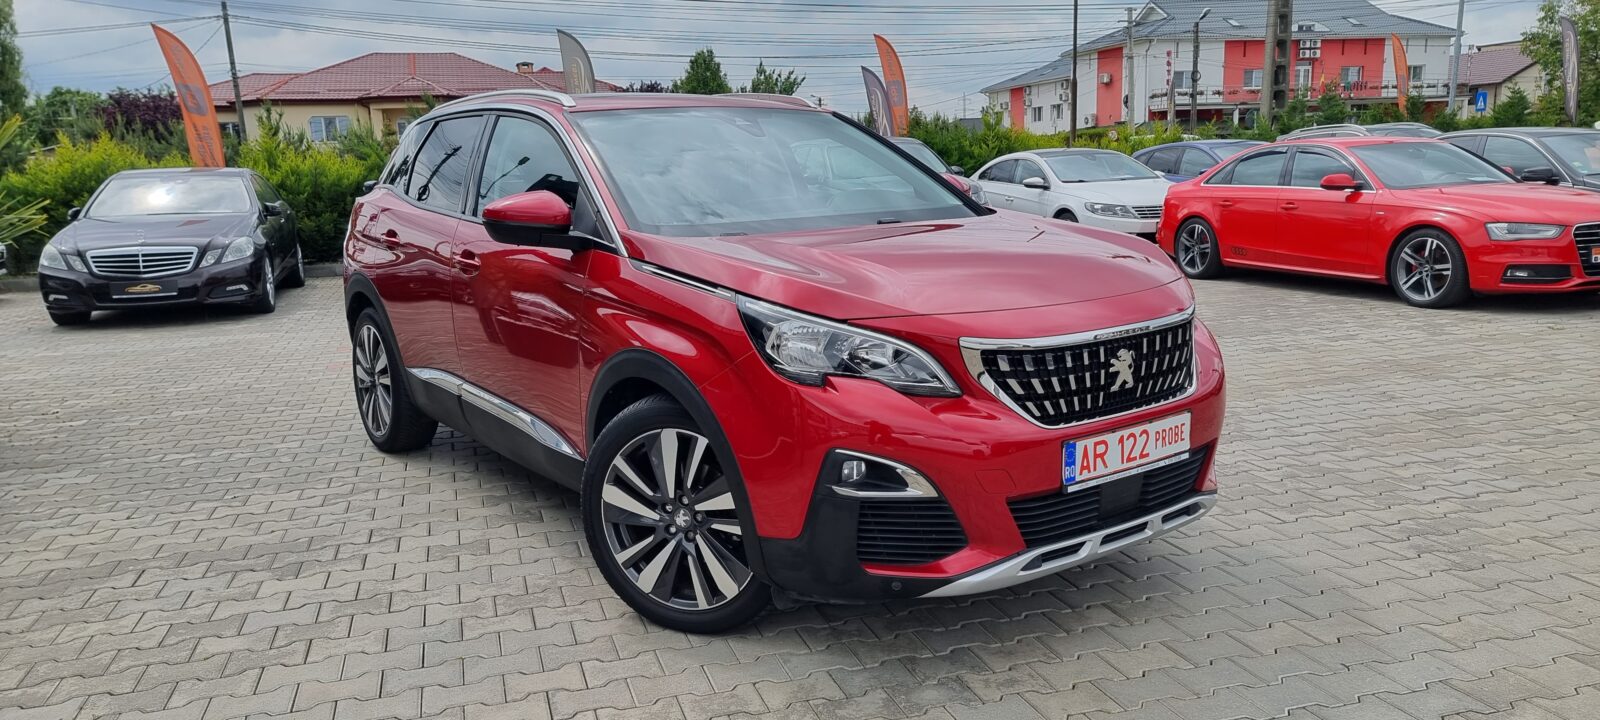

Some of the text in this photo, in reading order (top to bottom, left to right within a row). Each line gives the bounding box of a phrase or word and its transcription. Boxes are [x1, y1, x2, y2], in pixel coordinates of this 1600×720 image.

[1079, 439, 1109, 476] AR
[1117, 429, 1150, 465] 122
[1155, 422, 1186, 450] PROBE
[1065, 465, 1075, 479] RO
